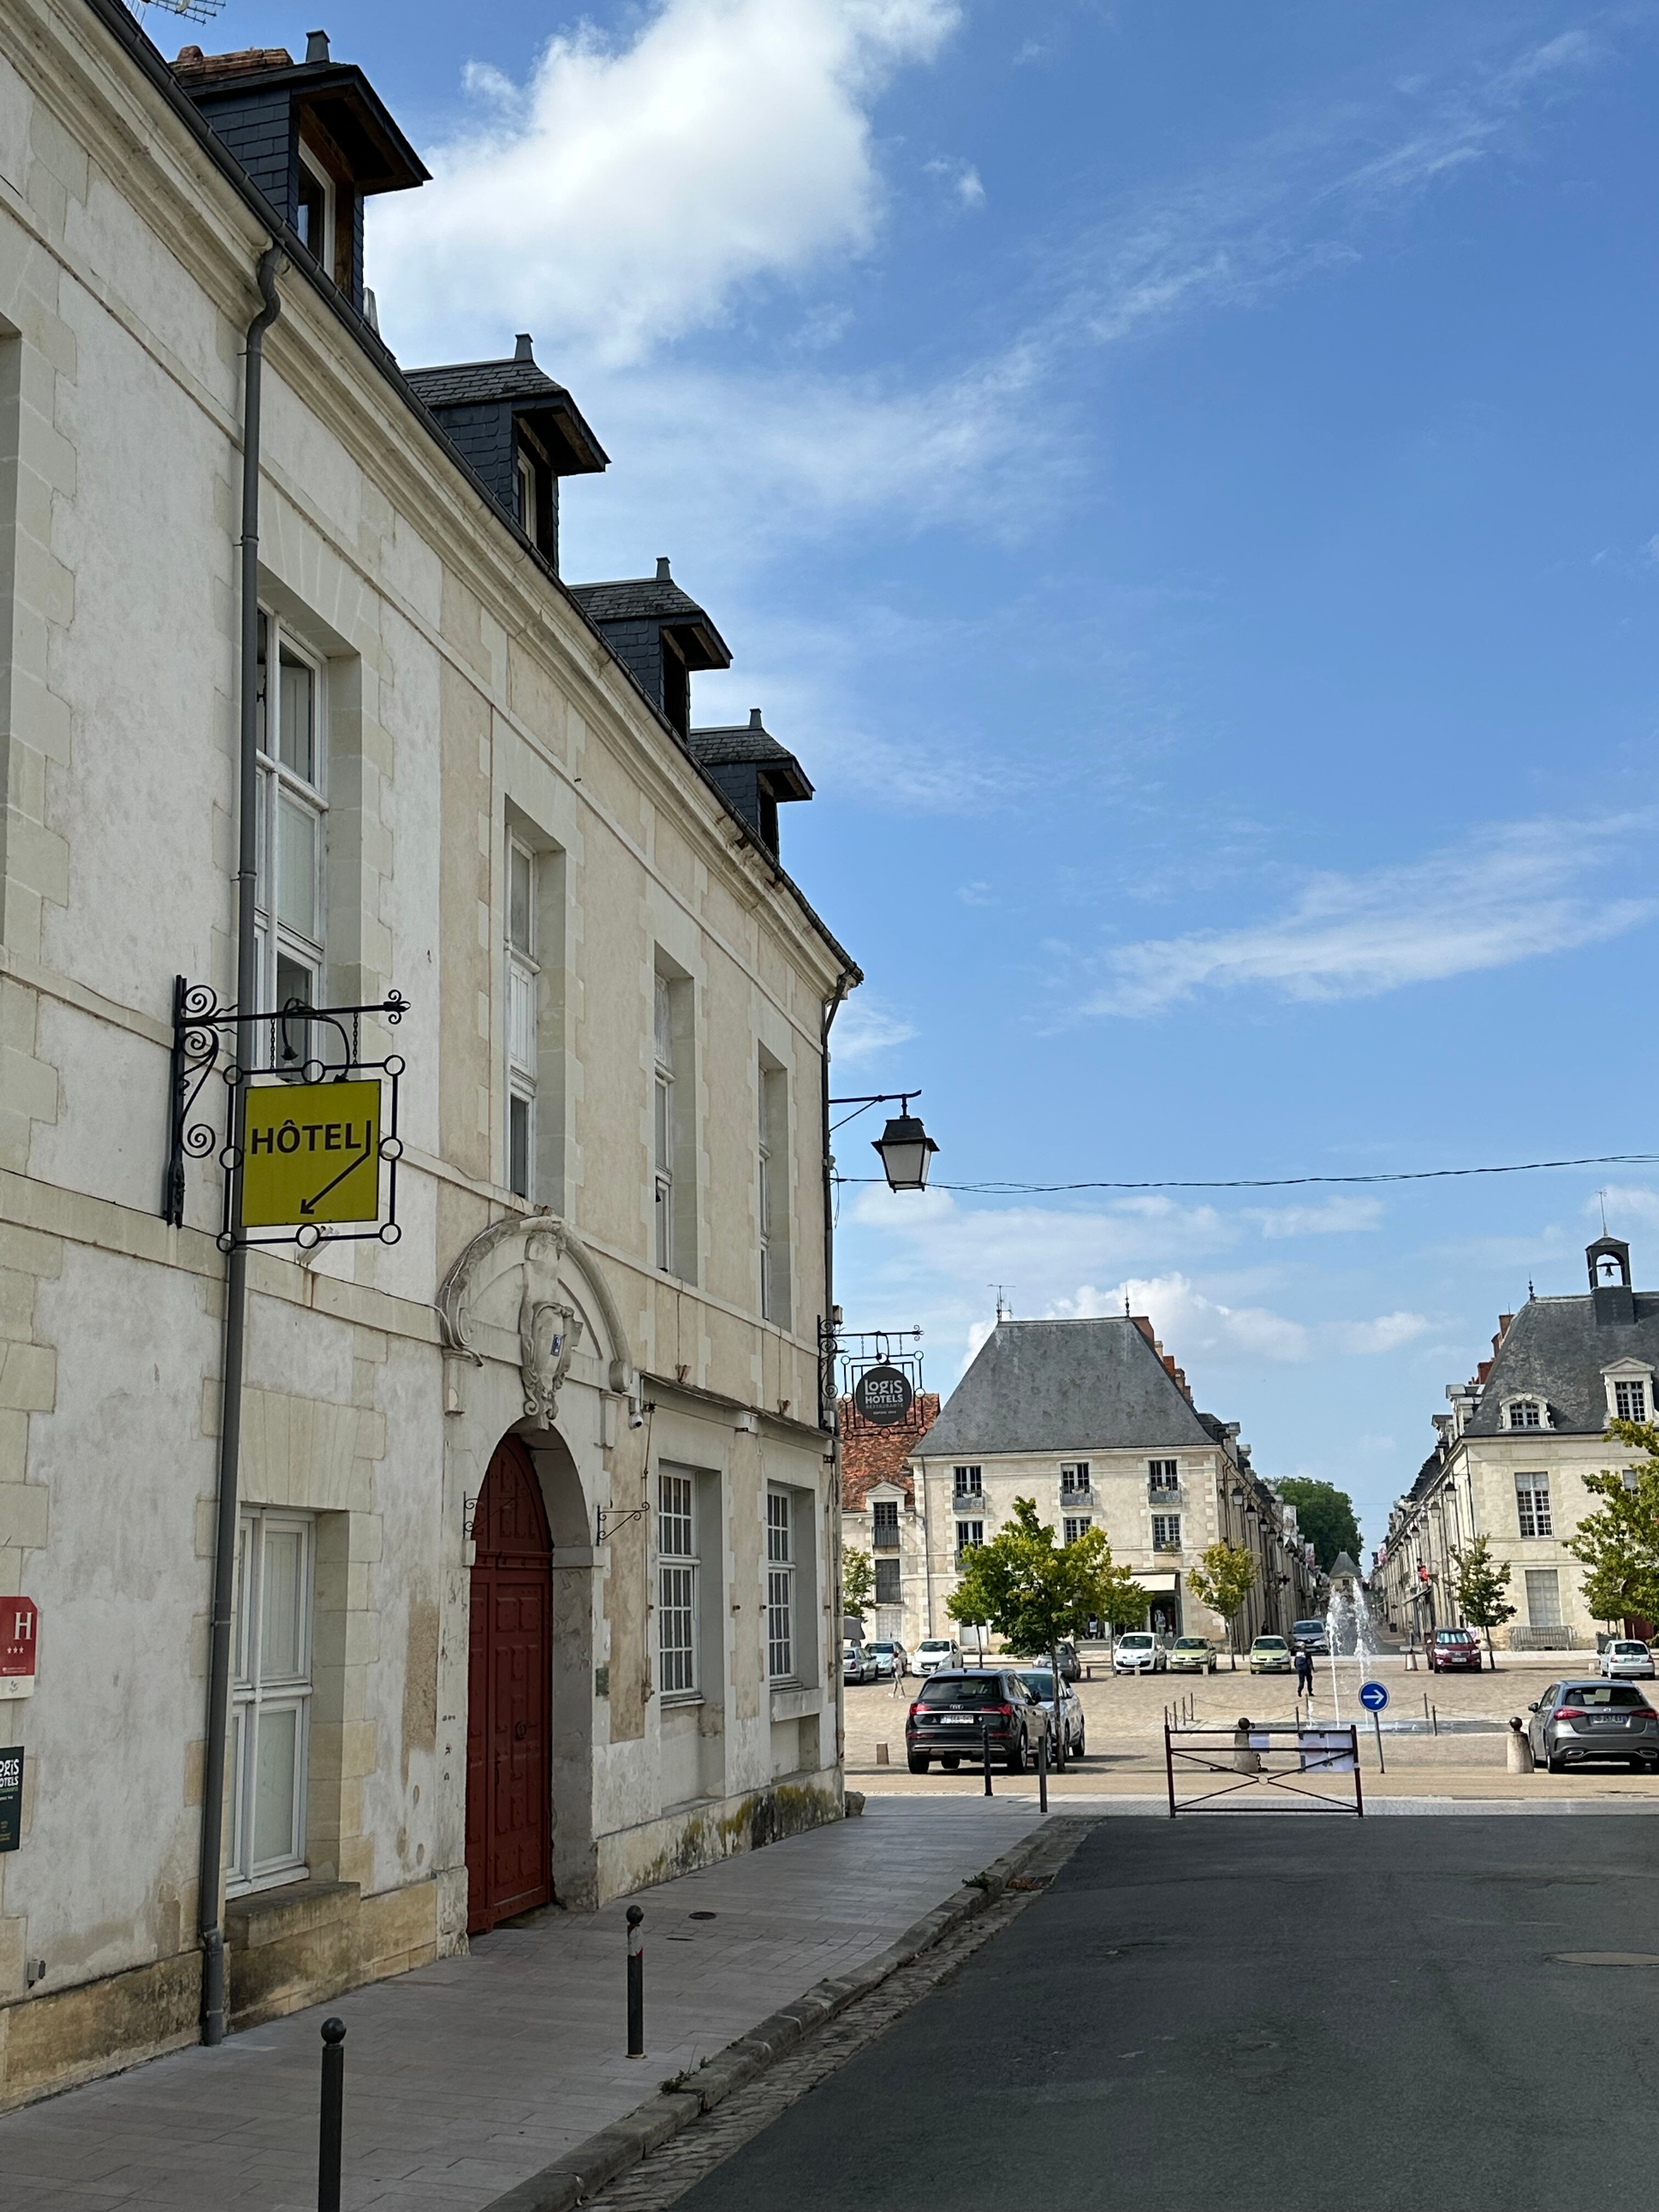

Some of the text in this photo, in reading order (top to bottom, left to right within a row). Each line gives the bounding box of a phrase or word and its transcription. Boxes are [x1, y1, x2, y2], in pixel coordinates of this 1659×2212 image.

[251, 1119, 362, 1155] HÔTEL
[865, 1394, 904, 1404] HOTELS
[13, 1611, 33, 1640] H
[0, 1758, 20, 1776] ogis
[0, 1775, 19, 1788] OTELS
